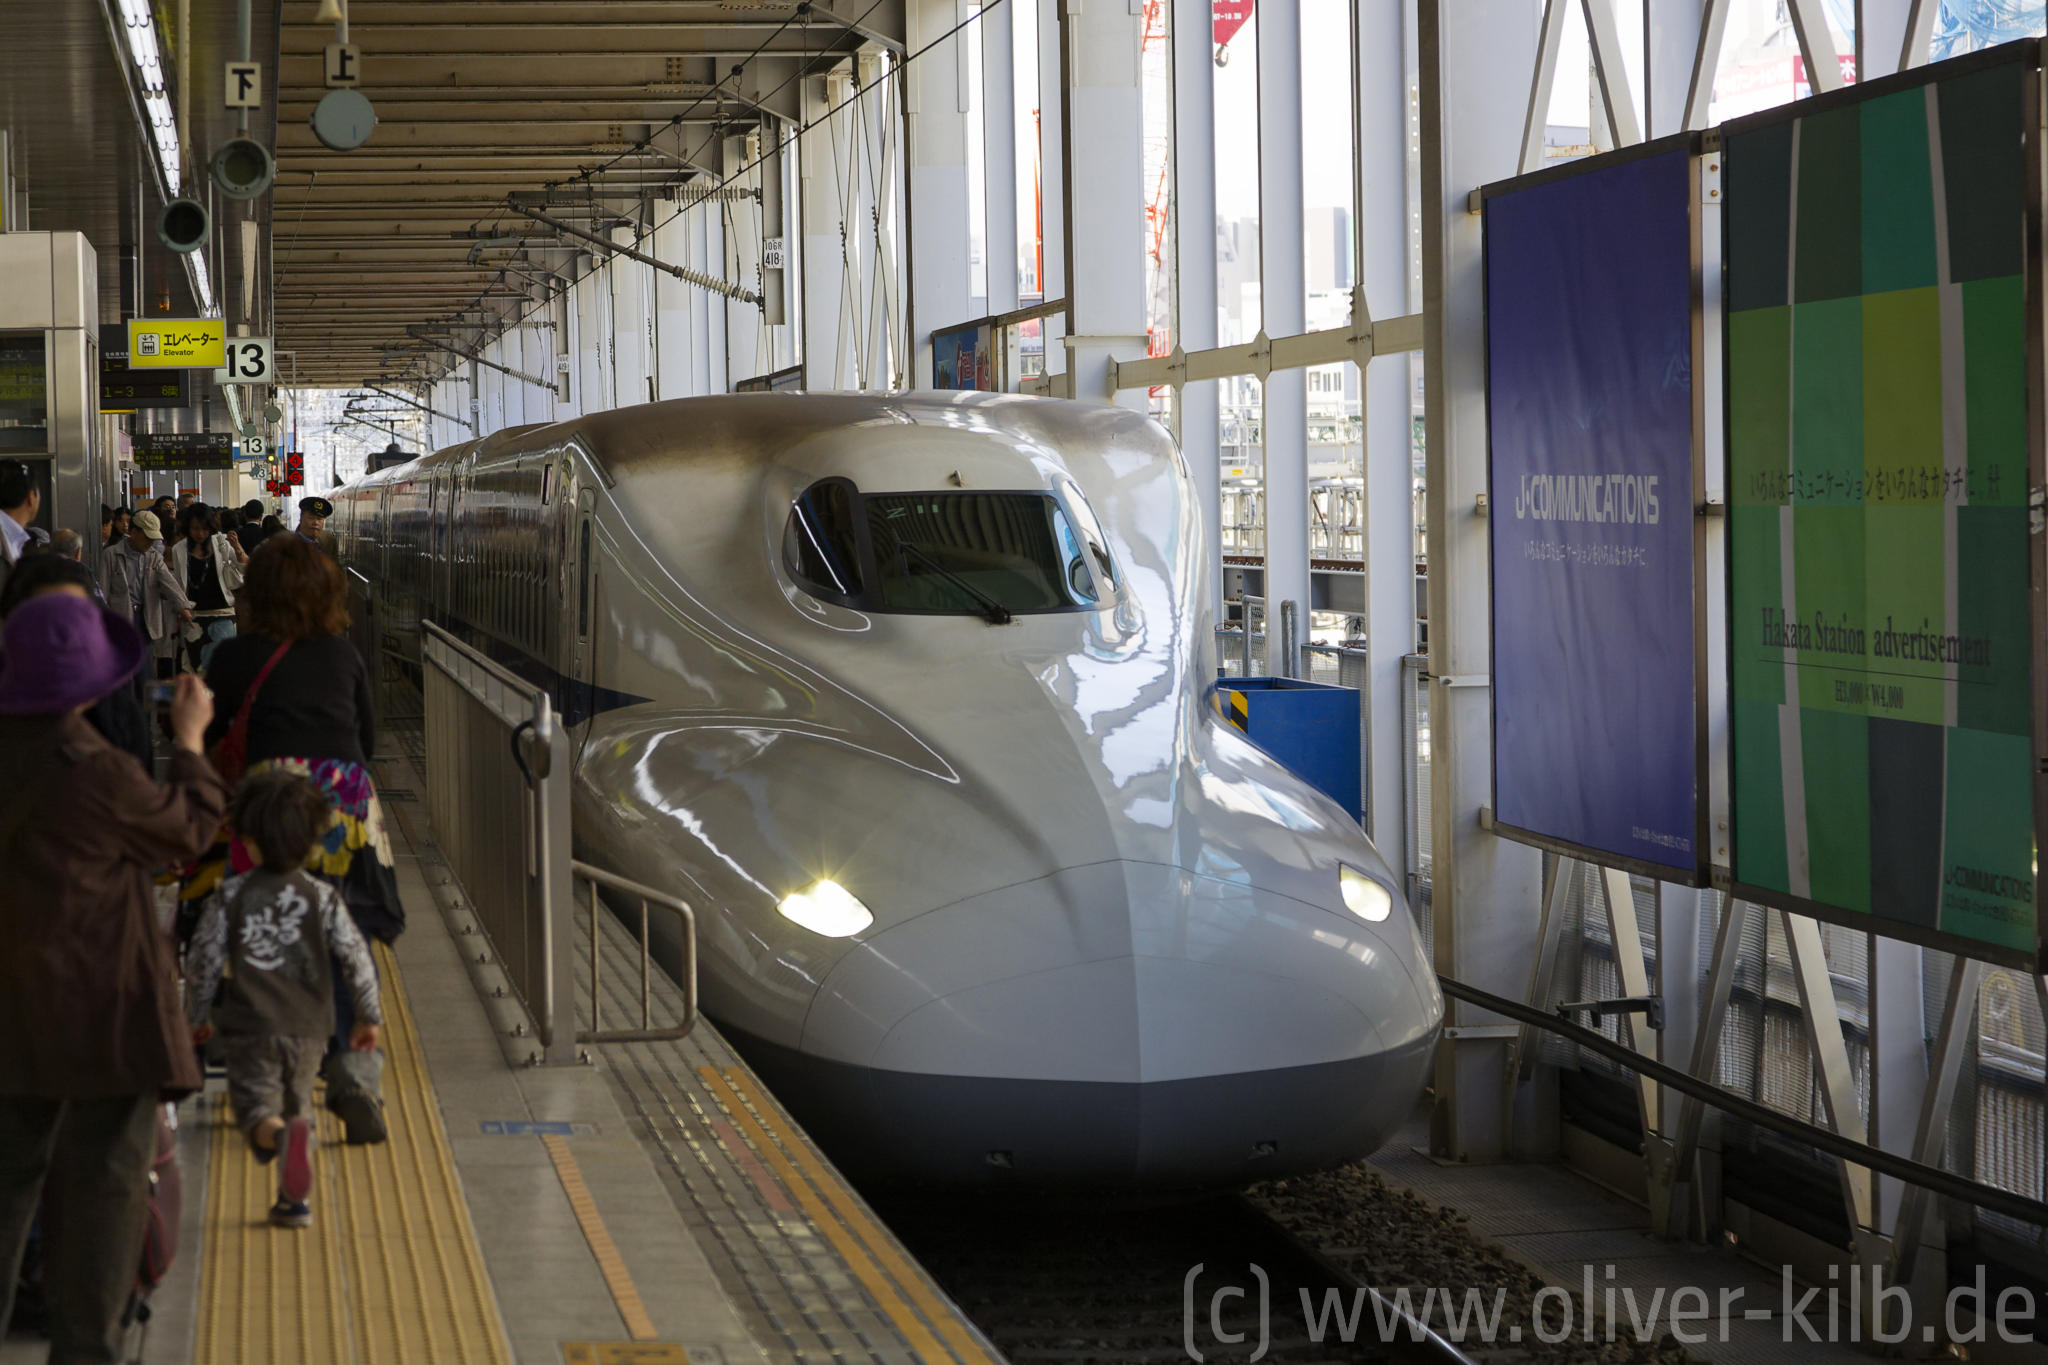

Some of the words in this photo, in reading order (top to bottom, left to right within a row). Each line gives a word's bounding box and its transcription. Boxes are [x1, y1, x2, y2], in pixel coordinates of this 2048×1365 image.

[331, 48, 355, 81] 上
[231, 68, 256, 101] 下
[163, 332, 219, 347] エレベーター
[226, 343, 266, 378] 13
[242, 438, 263, 454] 13
[1761, 607, 1812, 651] Hakata
[1814, 610, 1867, 656] Station
[1873, 615, 1993, 668] advertisement
